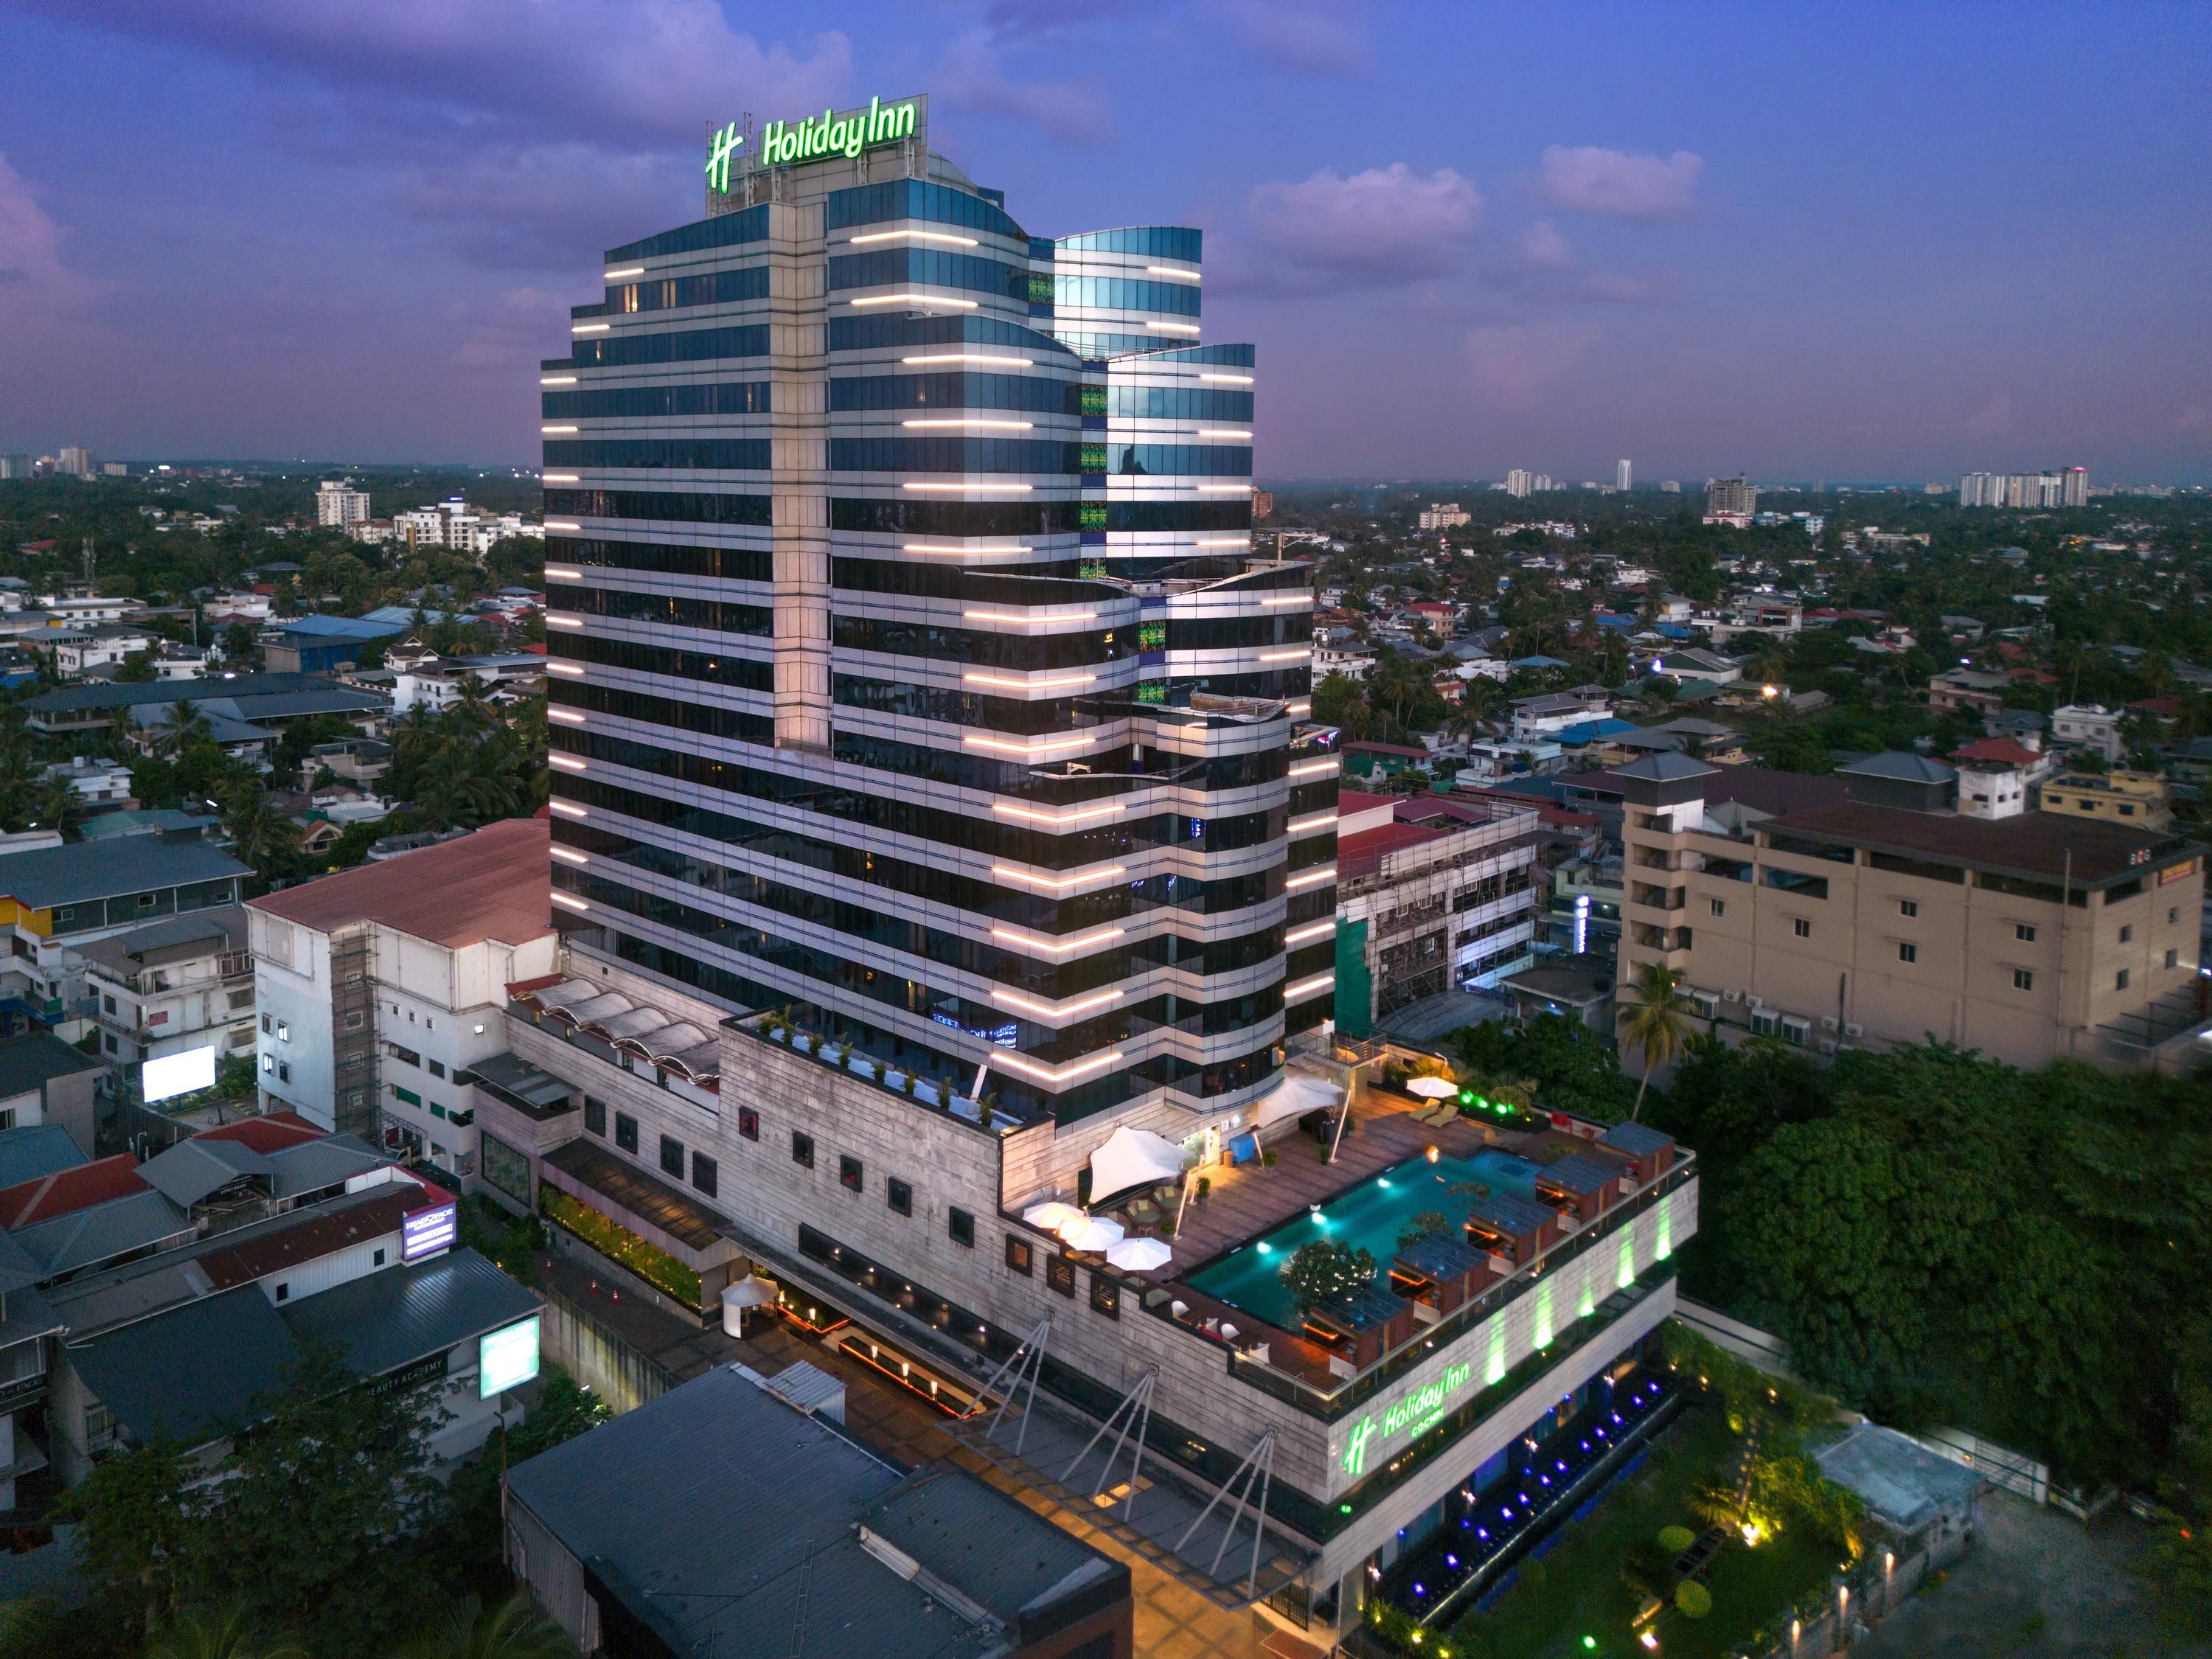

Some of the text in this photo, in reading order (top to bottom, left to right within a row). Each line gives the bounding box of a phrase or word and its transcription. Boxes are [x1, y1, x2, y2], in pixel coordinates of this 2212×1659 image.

[762, 108, 866, 165] Holiday
[867, 94, 917, 143] Inn
[366, 1377, 400, 1397] EAUTY
[1383, 1381, 1444, 1438] Holiday
[1445, 1362, 1470, 1394] Inn
[1410, 1407, 1444, 1439] COCHIN
